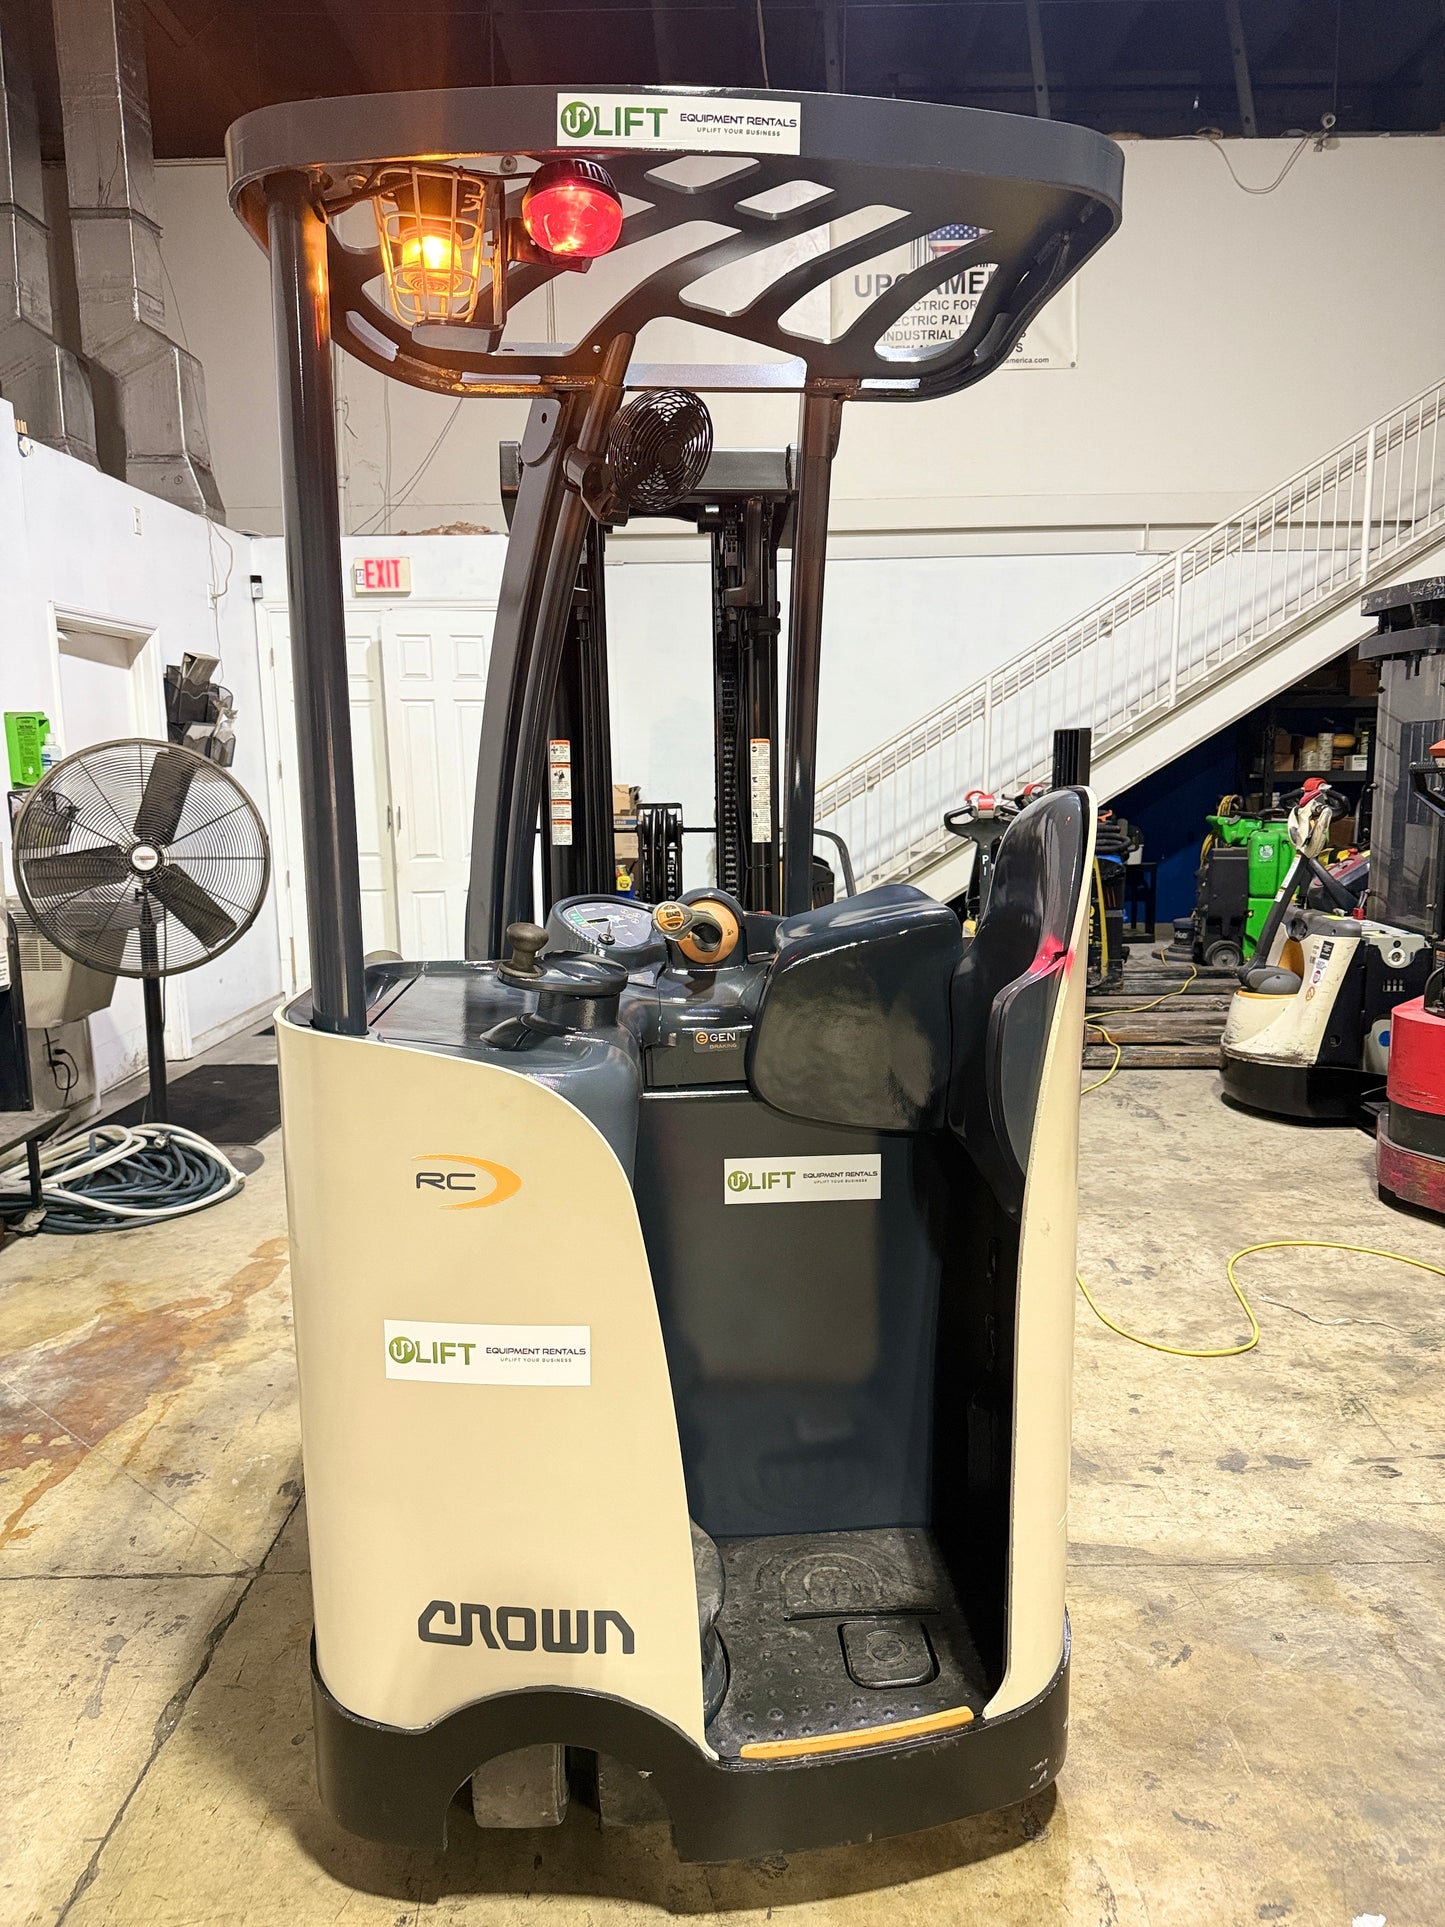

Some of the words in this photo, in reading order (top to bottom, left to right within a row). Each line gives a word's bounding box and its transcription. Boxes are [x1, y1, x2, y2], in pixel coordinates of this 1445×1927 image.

[680, 113, 744, 124] EQUIPMENT
[747, 116, 797, 128] RENTALS
[911, 301, 949, 311] CTRIC
[953, 300, 977, 310] FOR
[1005, 356, 1050, 364] america.com
[364, 560, 400, 588] EXIT
[416, 1172, 476, 1190] RC
[486, 1347, 540, 1355] EQUIPMENT
[418, 1600, 634, 1654] CROWN
